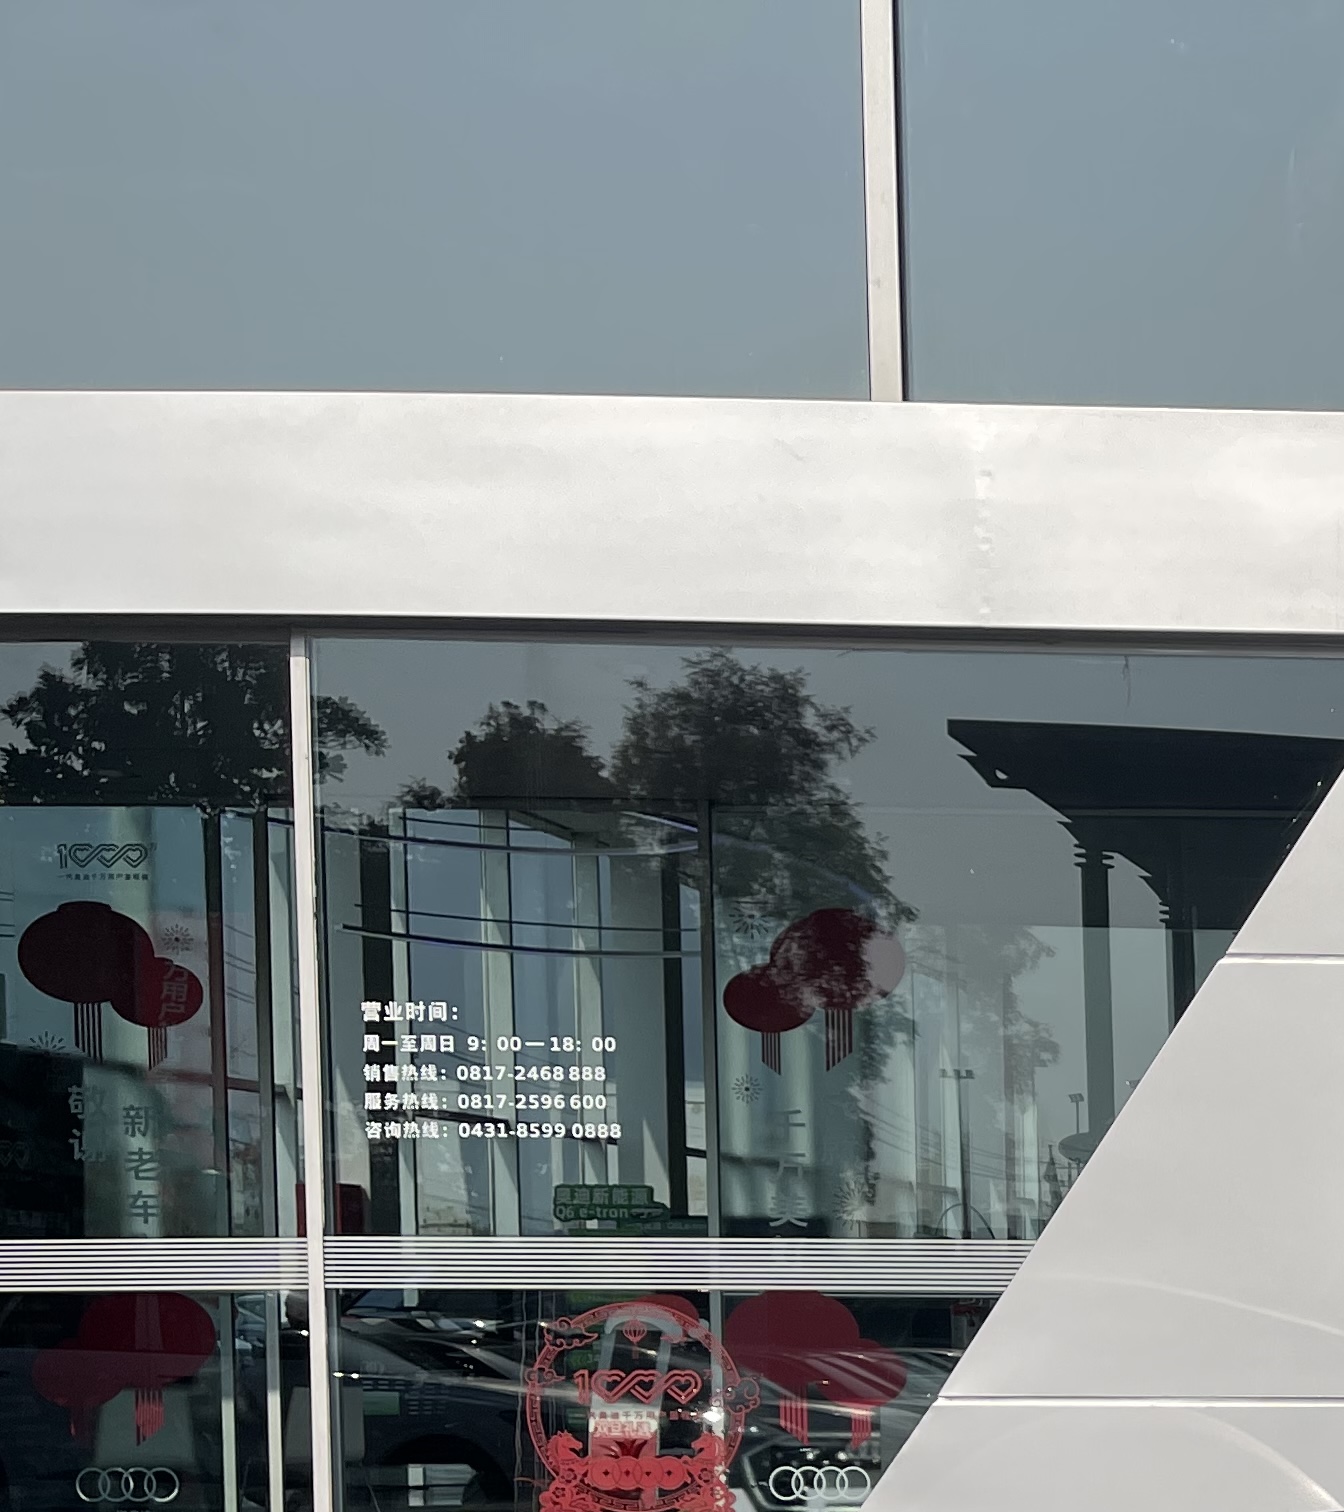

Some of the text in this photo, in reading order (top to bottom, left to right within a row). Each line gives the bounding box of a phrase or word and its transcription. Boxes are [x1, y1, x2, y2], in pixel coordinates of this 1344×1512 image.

[361, 1001, 458, 1022] 营业时间：
[363, 1034, 454, 1052] 周一至周日
